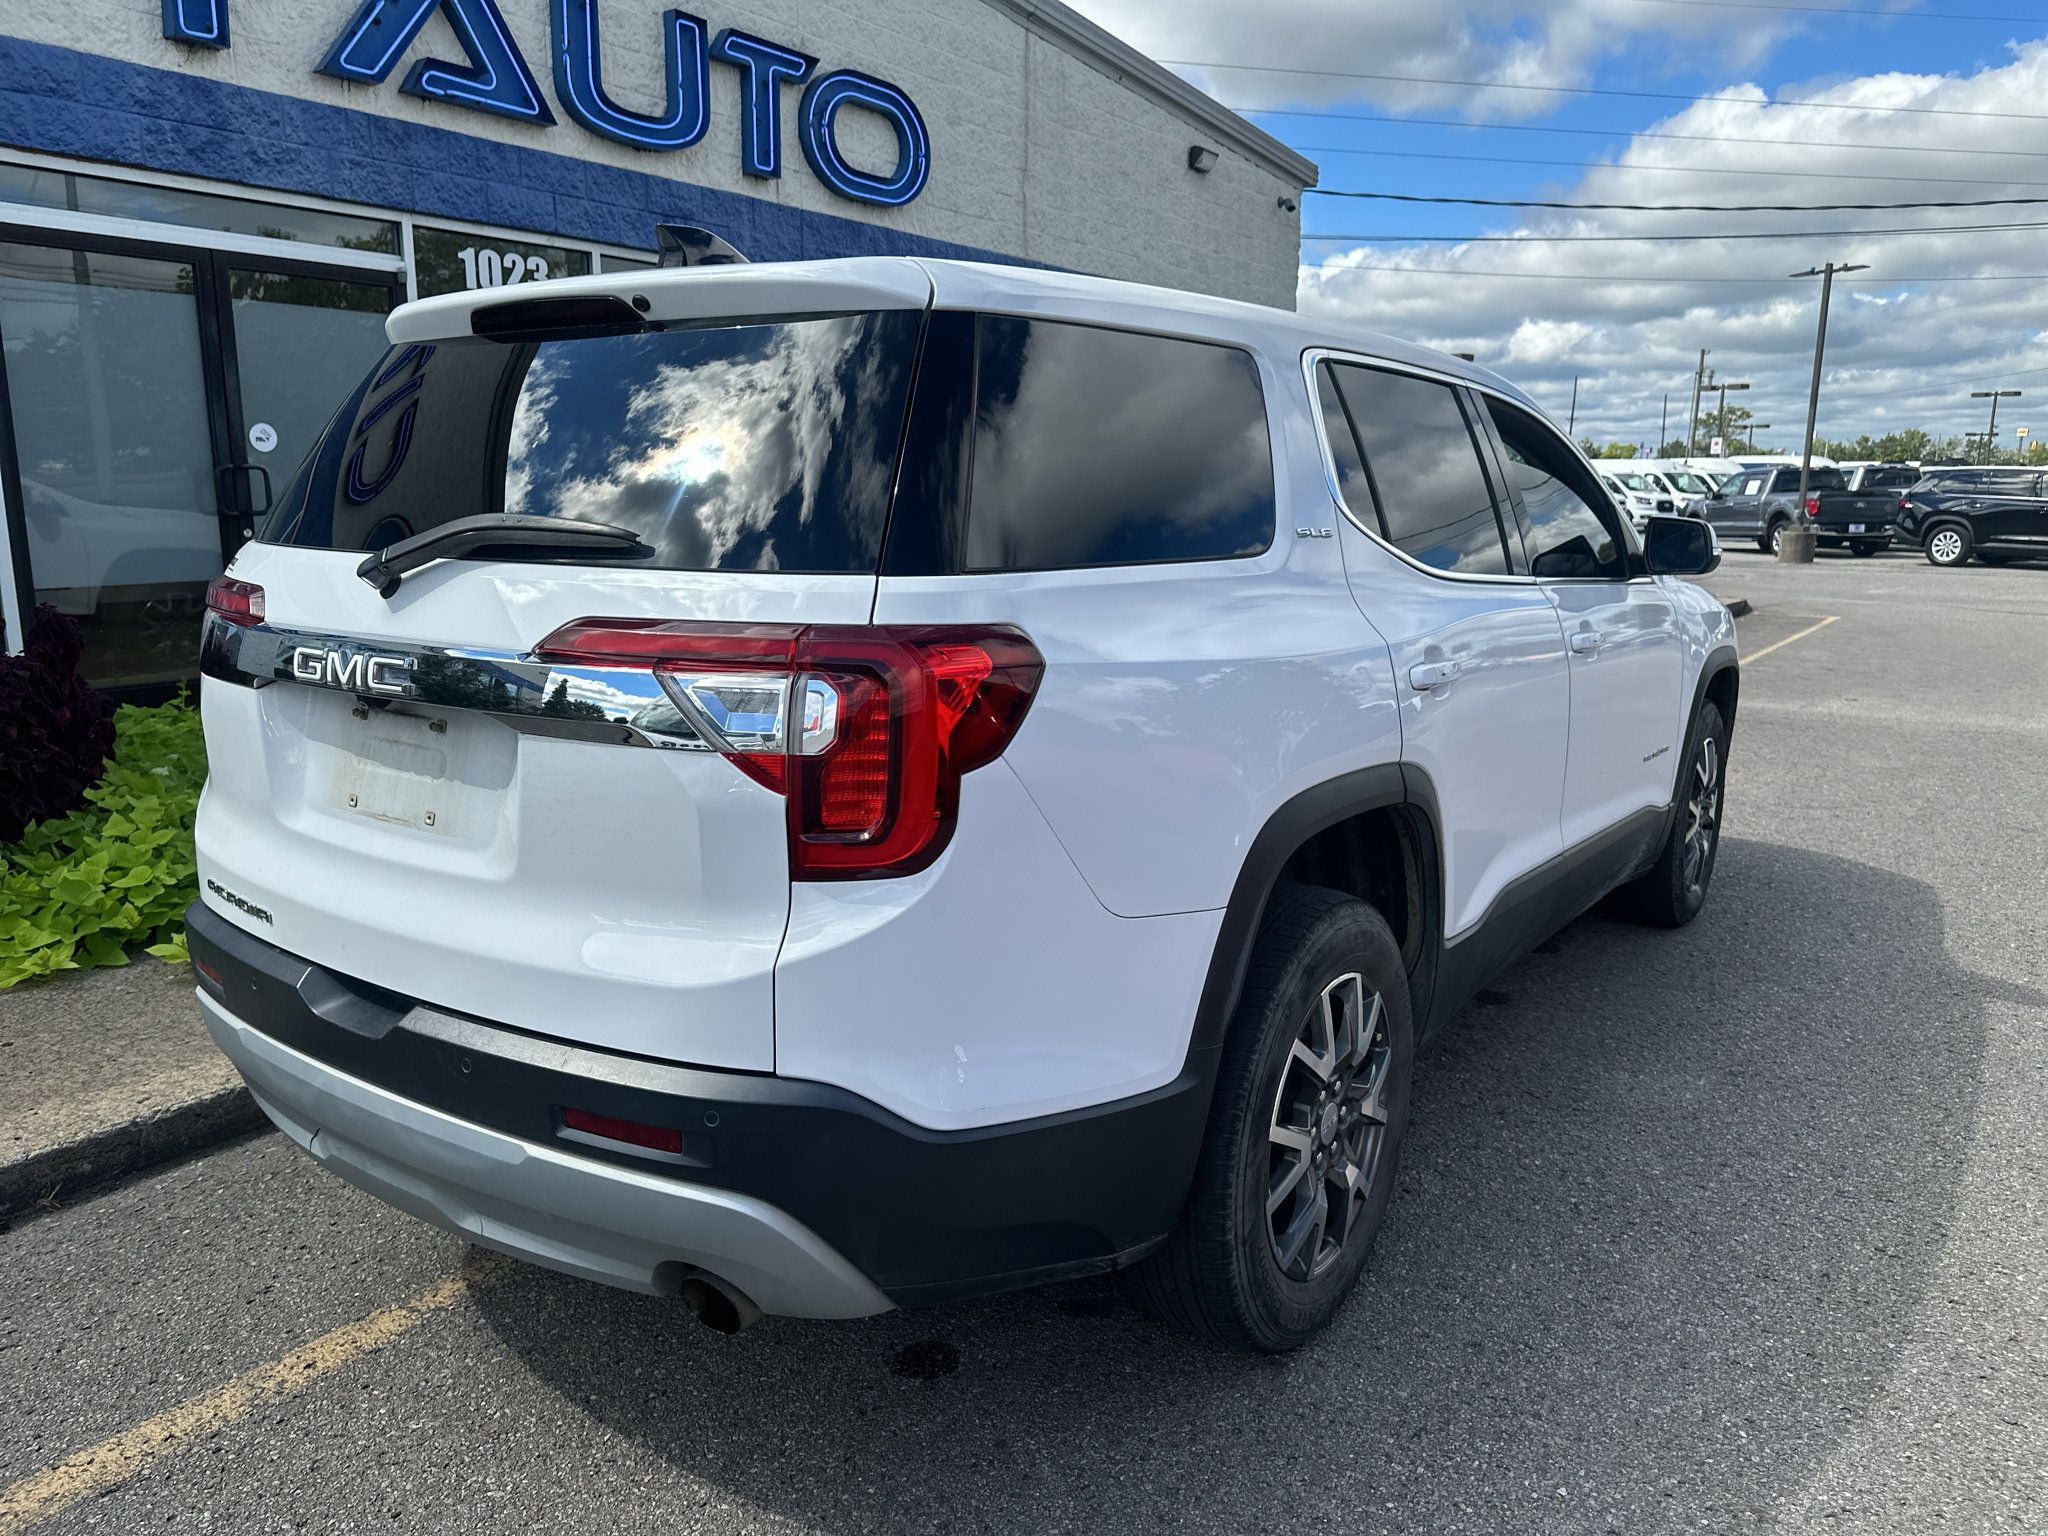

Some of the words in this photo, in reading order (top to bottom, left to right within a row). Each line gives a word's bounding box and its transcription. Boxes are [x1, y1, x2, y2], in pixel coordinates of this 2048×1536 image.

[313, 0, 932, 207] AUTO
[457, 246, 550, 290] 1023
[1296, 527, 1334, 539] SLE
[293, 646, 418, 696] GMC
[207, 878, 274, 927] ACADIA
